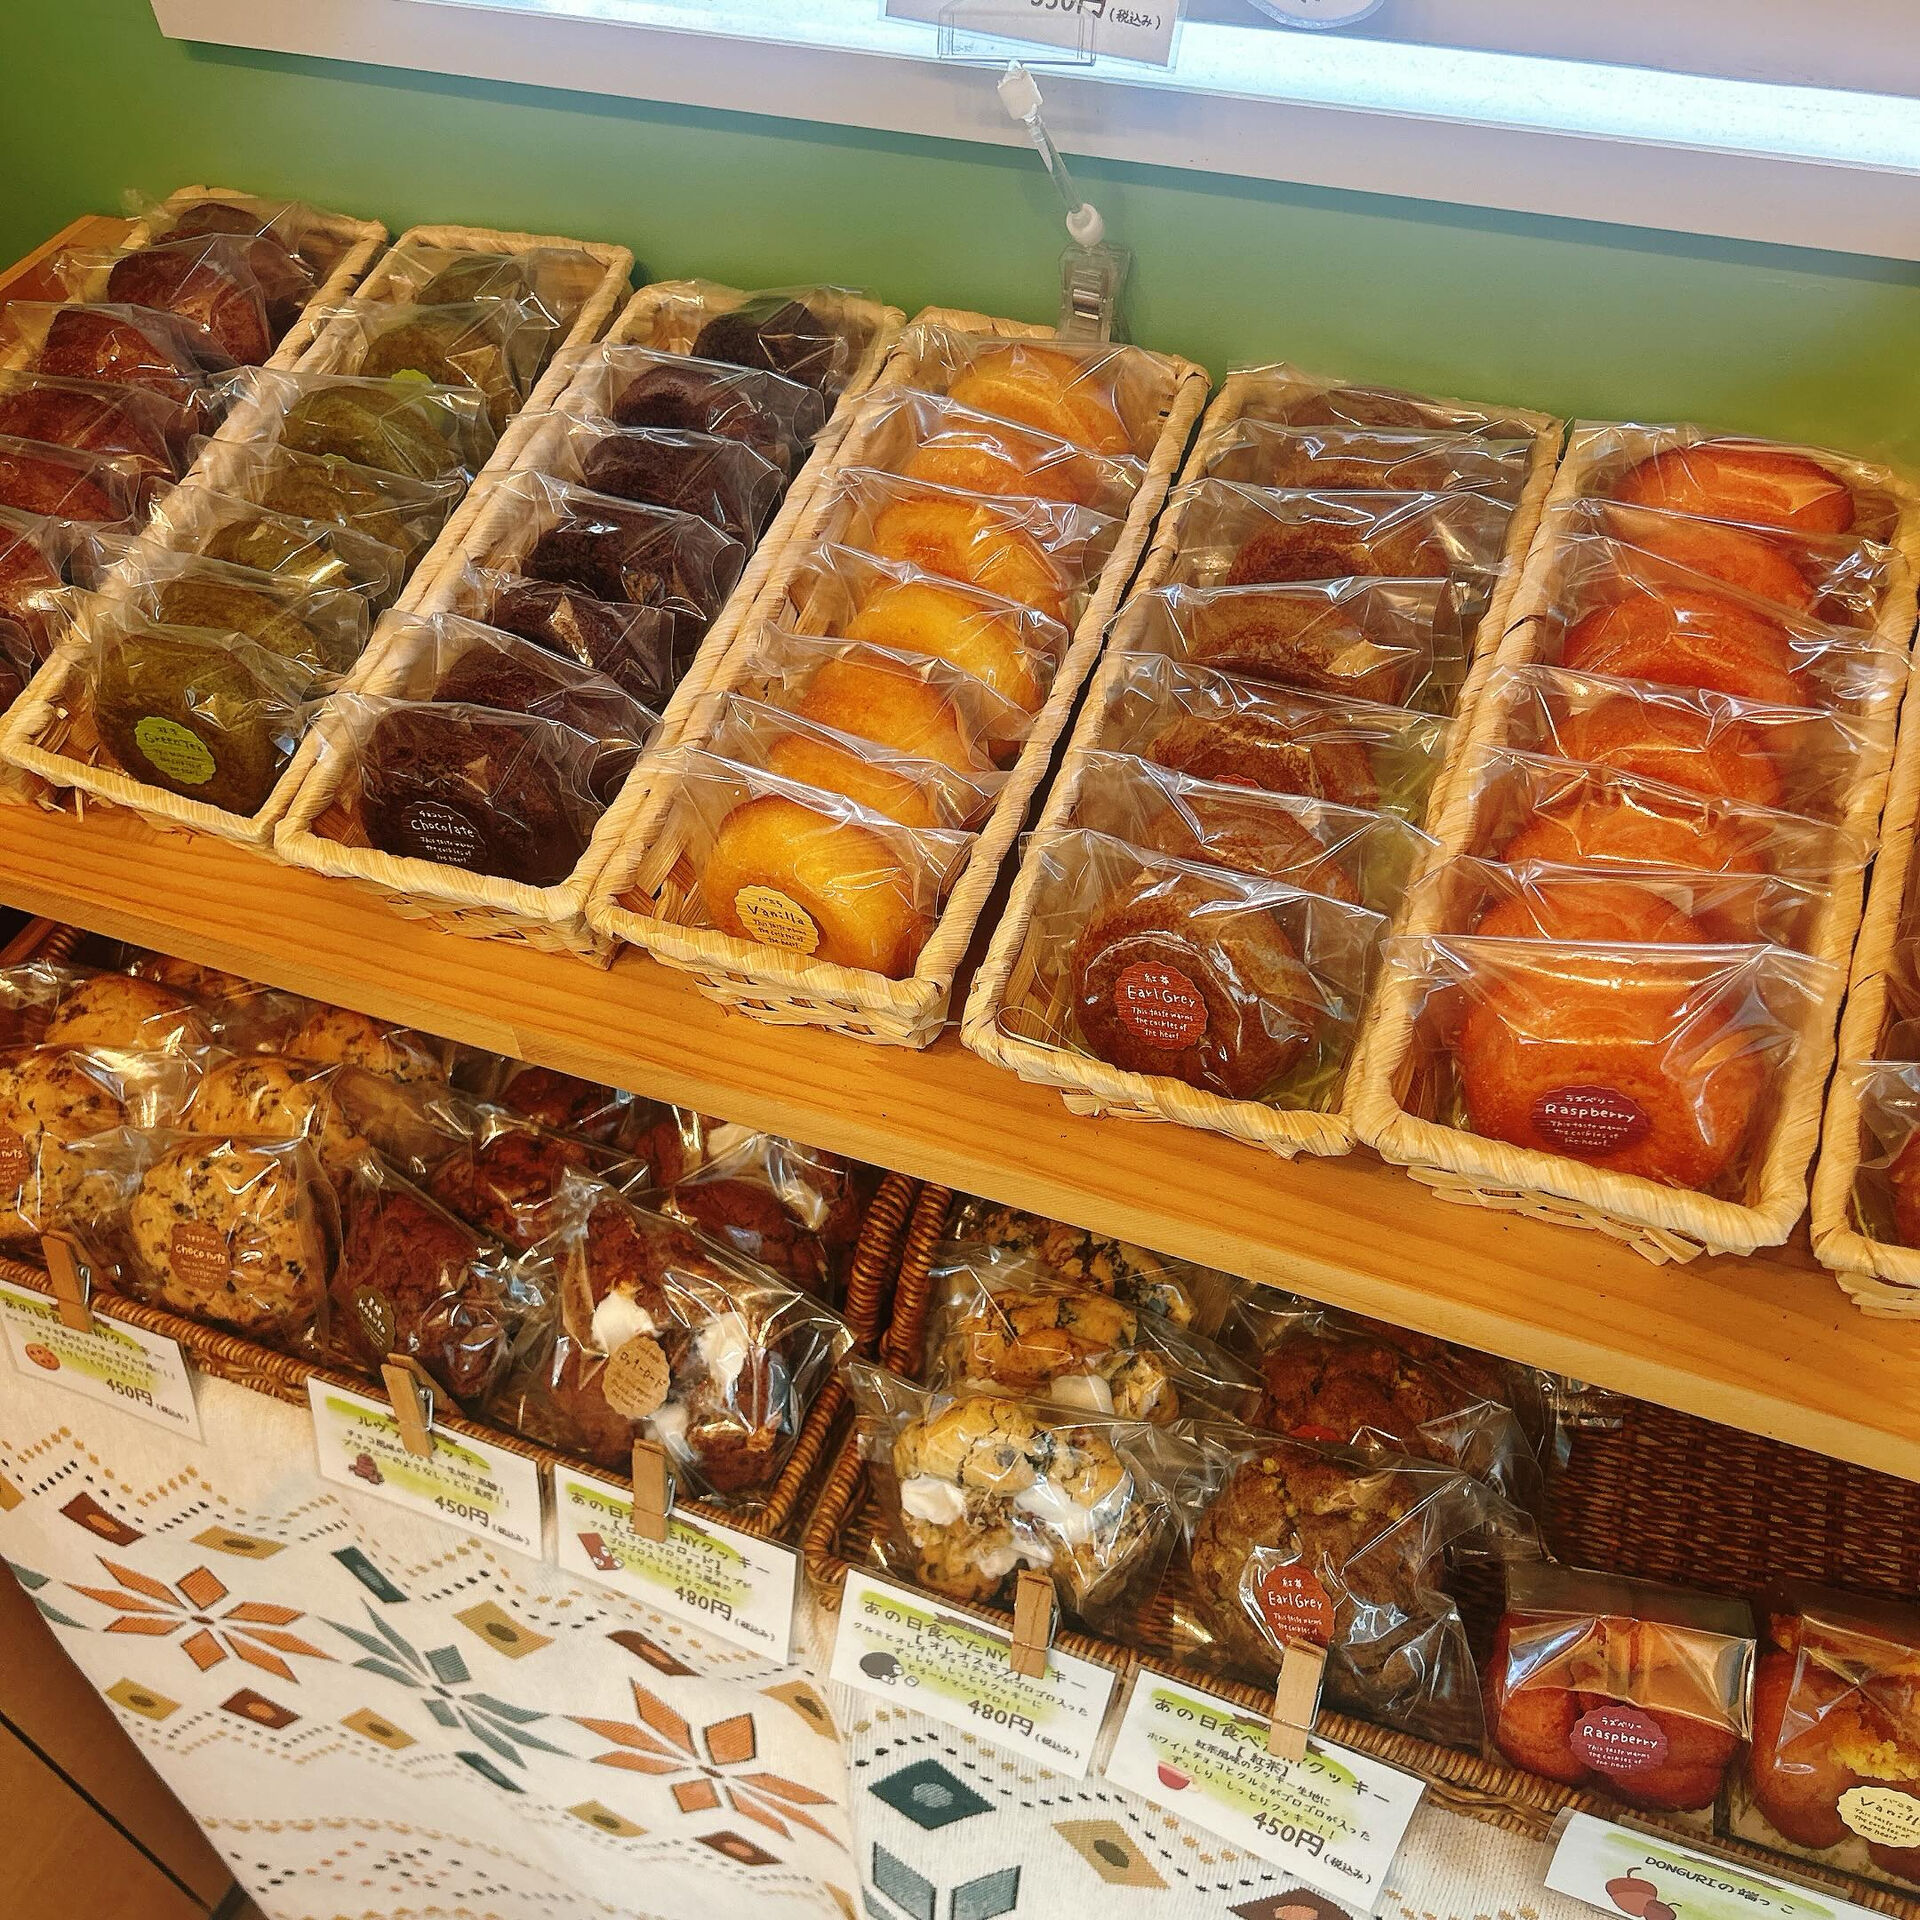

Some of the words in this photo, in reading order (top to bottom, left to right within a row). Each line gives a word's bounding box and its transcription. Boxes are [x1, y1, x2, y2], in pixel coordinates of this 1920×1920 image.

[410, 819, 475, 838] Chocolate
[746, 903, 806, 926] Vanilla
[1127, 985, 1159, 1000] Earl
[1162, 989, 1196, 1008] Grey
[1131, 1006, 1147, 1015] This
[1149, 1008, 1169, 1018] taste
[1170, 1012, 1194, 1022] warms
[1135, 1016, 1148, 1025] the
[1149, 1019, 1178, 1030] cockles
[1179, 1023, 1188, 1031] of
[1144, 1028, 1157, 1037] the
[1159, 1029, 1180, 1039] heart
[1545, 1103, 1636, 1123] Raspberry
[104, 1375, 154, 1408] 450円
[433, 1492, 489, 1528] 450円
[674, 1583, 732, 1622] 480円
[1267, 1591, 1293, 1606] Earl
[1295, 1594, 1323, 1610] Grey
[966, 1695, 1034, 1737] 480円
[1583, 1725, 1658, 1749] Raspberry
[1587, 1743, 1603, 1751] This
[1605, 1746, 1625, 1755] taste
[1626, 1750, 1651, 1759] warms
[1588, 1751, 1601, 1759] the
[1860, 1796, 1920, 1827] Vanill
[1250, 1807, 1325, 1858] 450円
